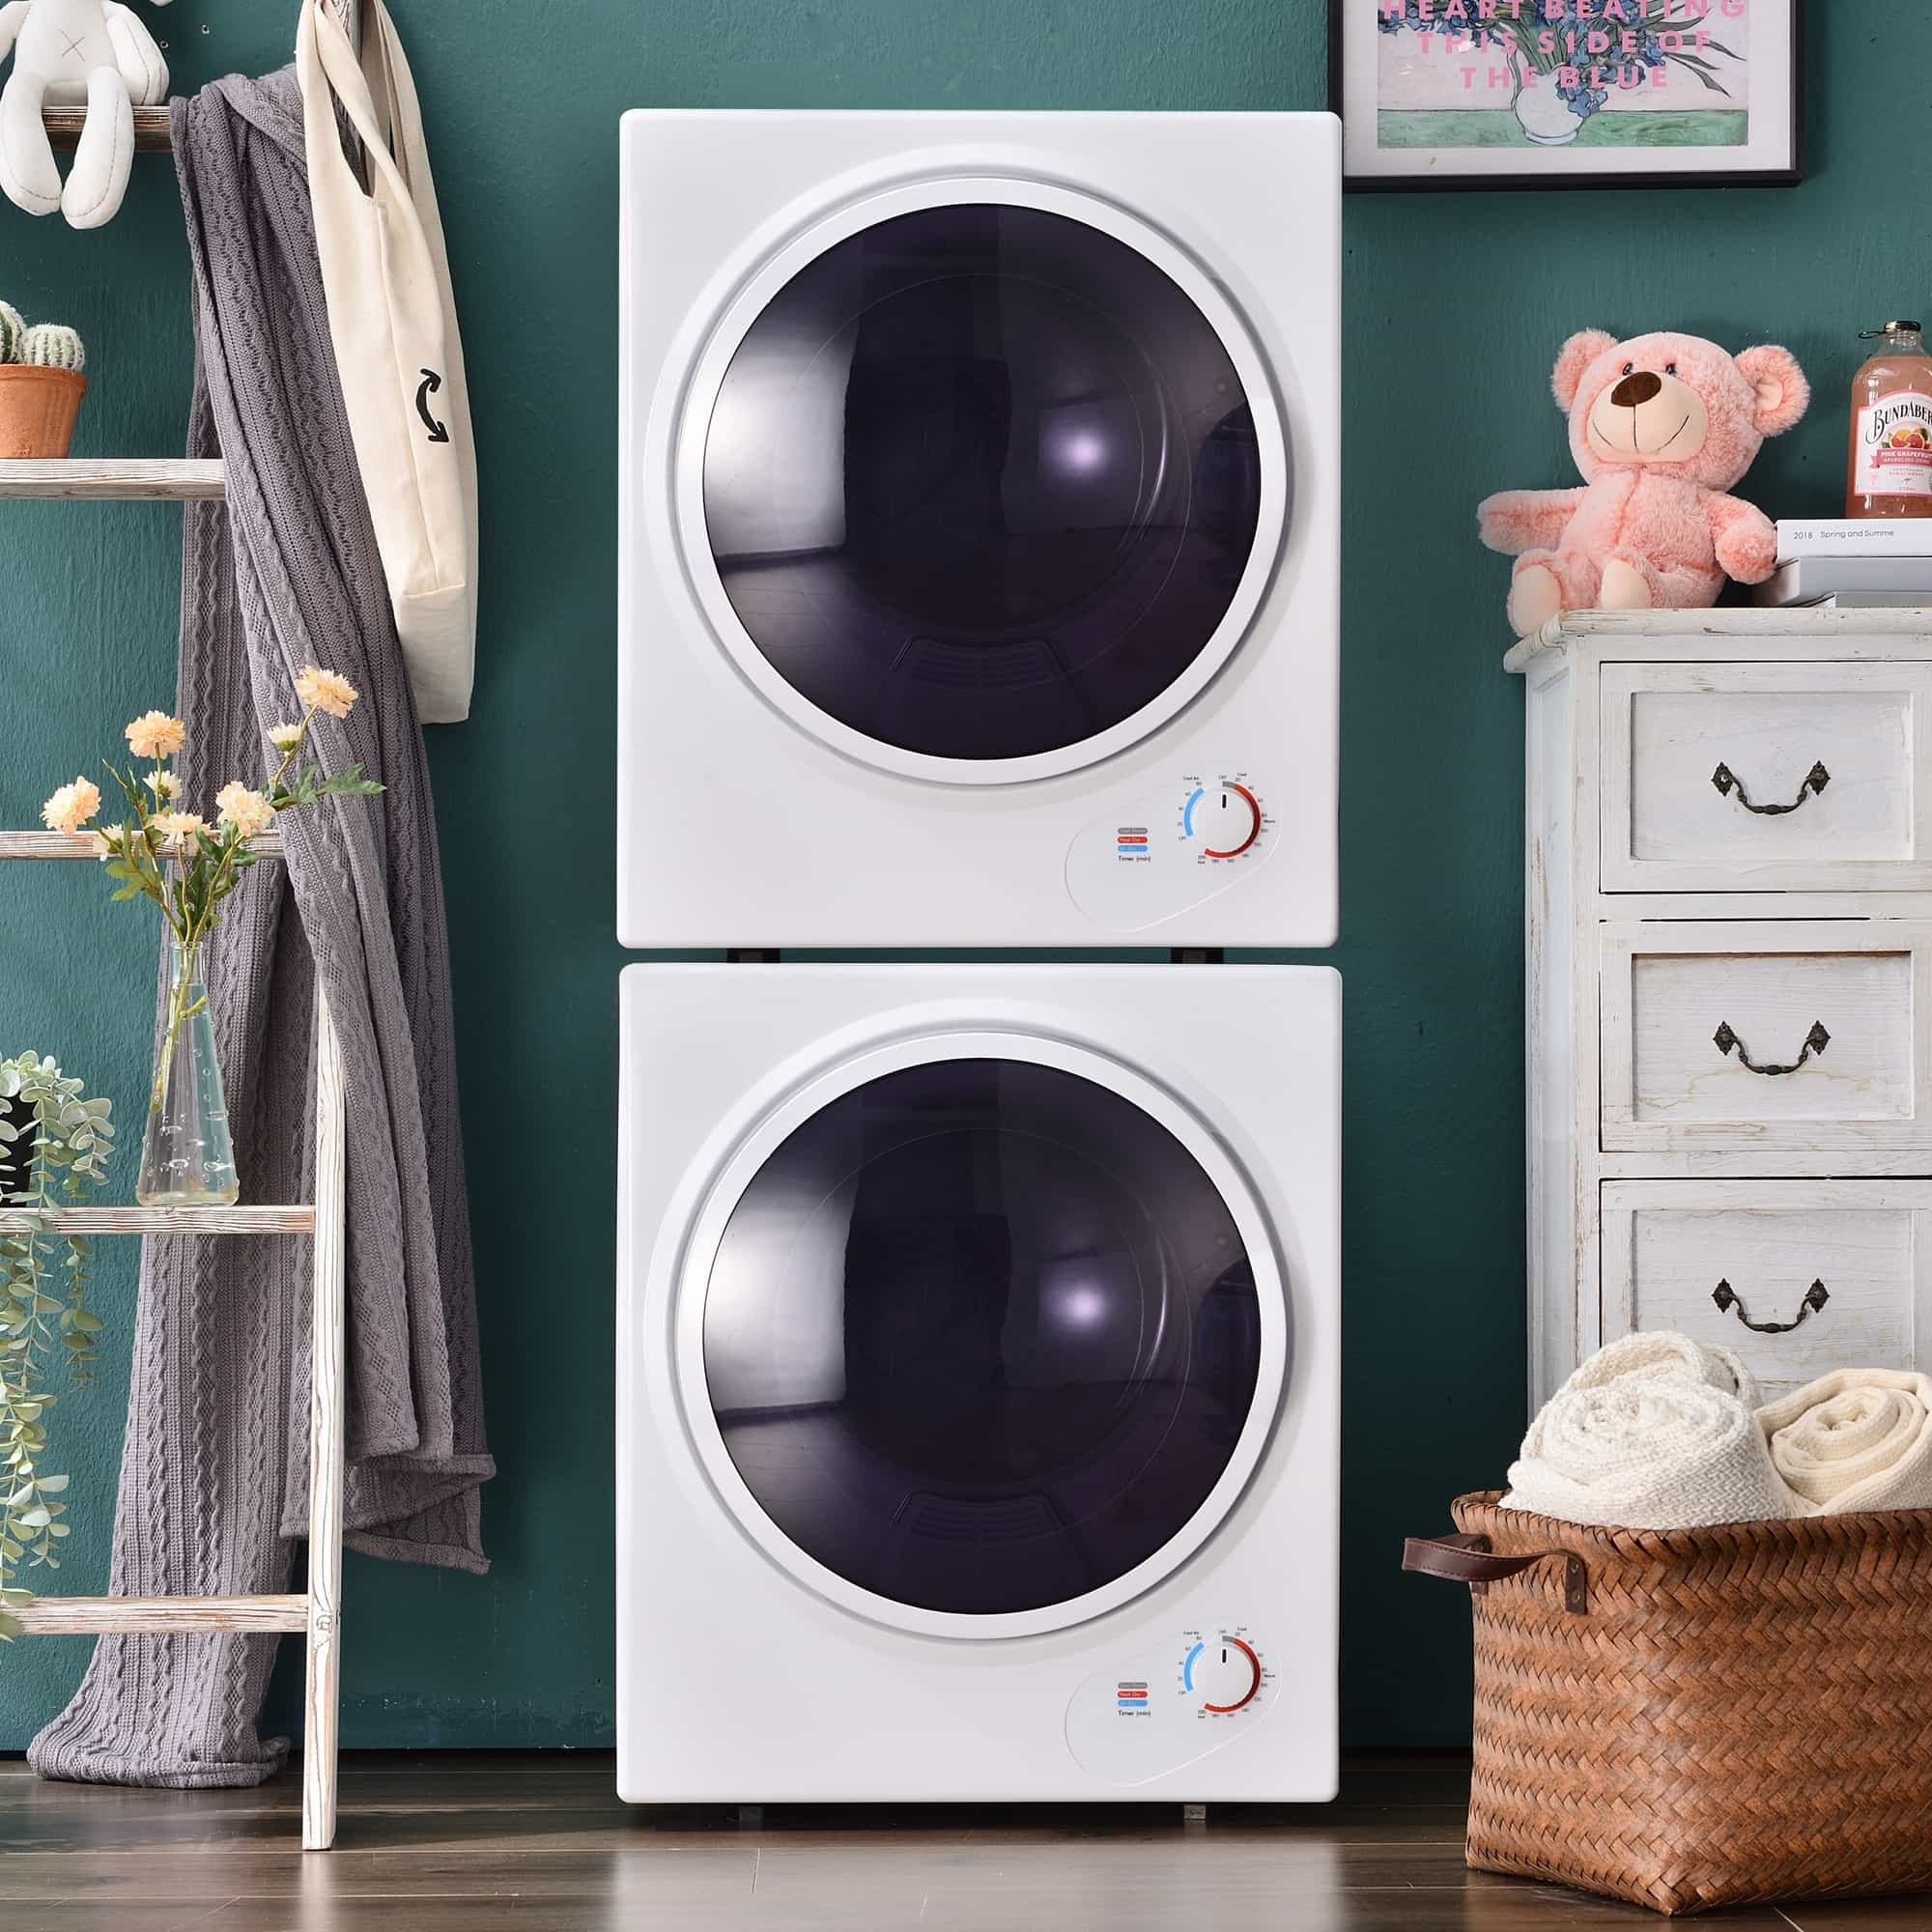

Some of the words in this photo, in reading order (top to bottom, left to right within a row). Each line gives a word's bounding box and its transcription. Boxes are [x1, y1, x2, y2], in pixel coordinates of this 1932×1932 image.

[1384, 0, 1523, 19] HEART
[1545, 0, 1746, 18] BEATING
[1417, 31, 1518, 54] THIS
[1538, 31, 1637, 53] SIDE
[1659, 31, 1711, 52] OF
[1461, 67, 1539, 89] THE
[1560, 66, 1667, 89] BLUE
[1793, 531, 1813, 540] 2018
[1820, 530, 1846, 539] Spring
